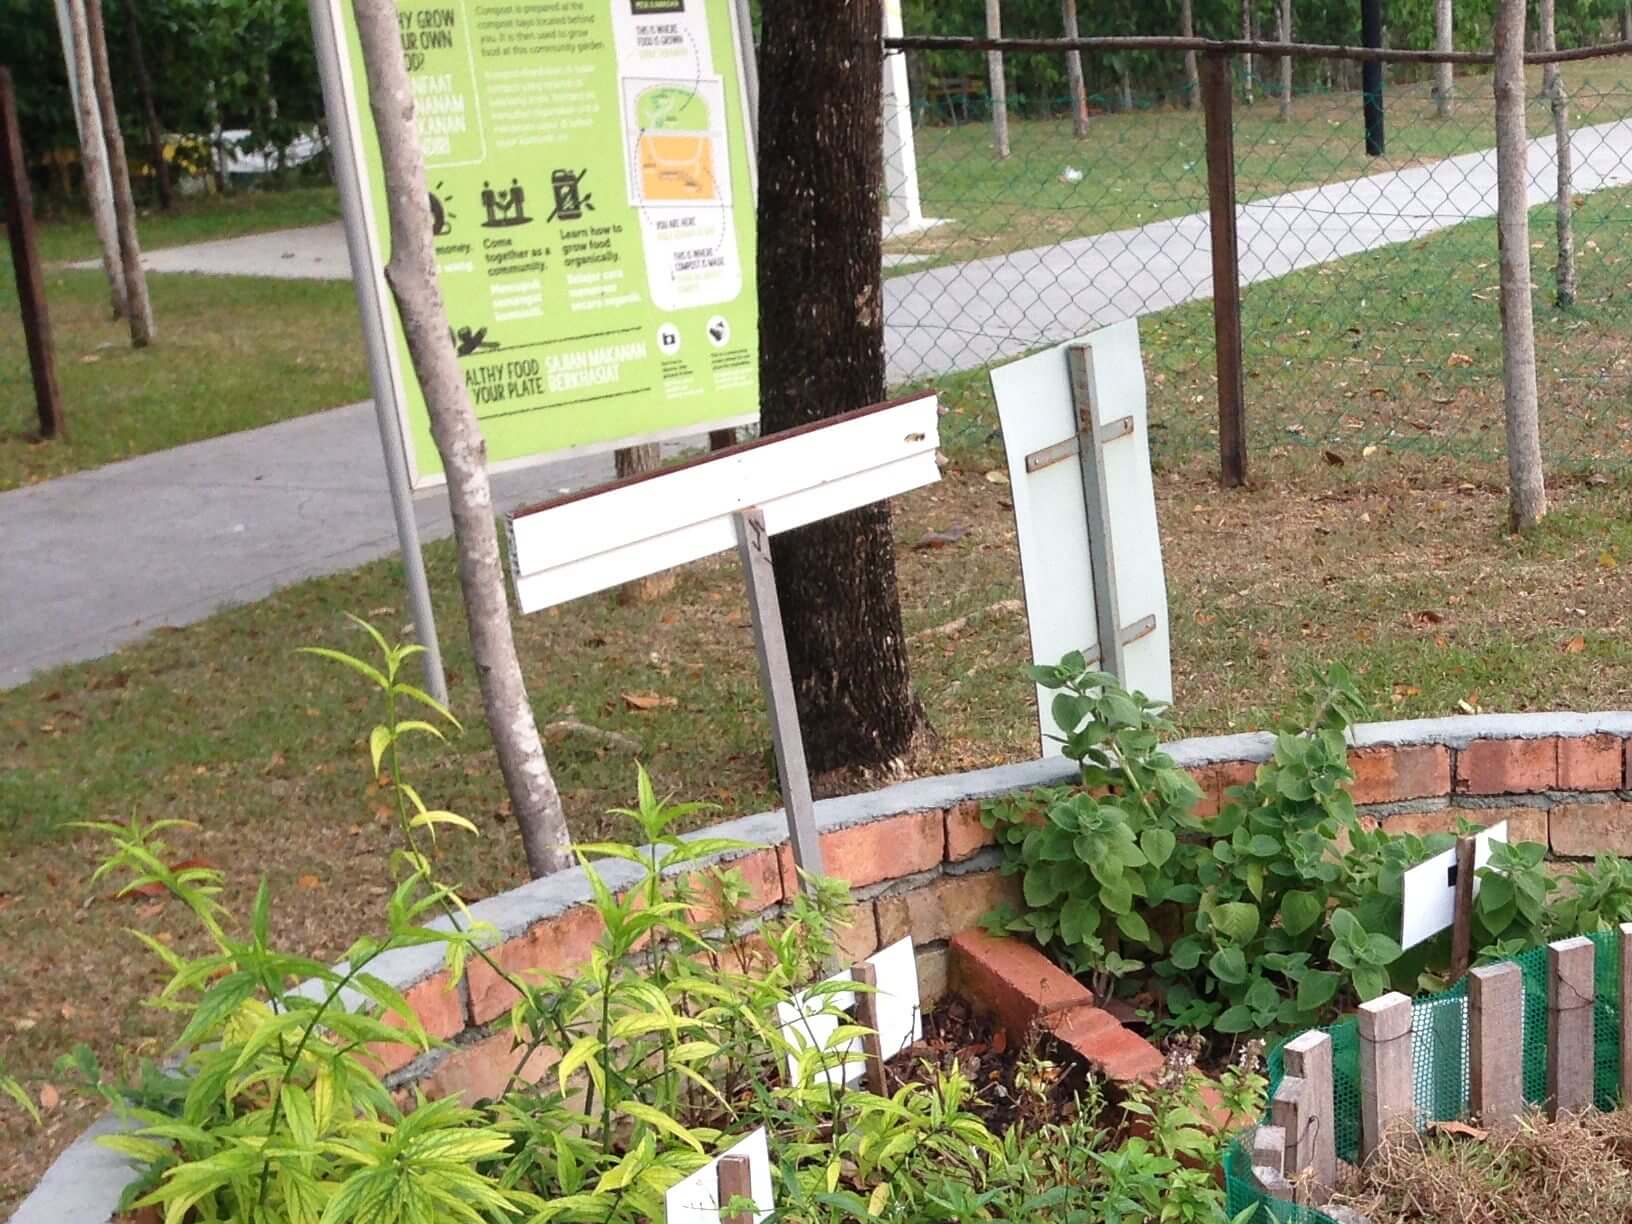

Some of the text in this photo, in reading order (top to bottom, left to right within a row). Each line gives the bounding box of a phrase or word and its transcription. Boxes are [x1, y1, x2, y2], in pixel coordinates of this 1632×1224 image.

[396, 8, 454, 29] HY GROW
[400, 29, 453, 50] UR OWN
[560, 224, 623, 240] Learn how to
[483, 238, 512, 249] Come
[562, 238, 611, 256] grow food
[485, 249, 529, 264] together
[531, 248, 543, 257] as
[465, 358, 540, 388] ALTHY FOOD
[473, 377, 545, 405] YOUR PLATE
